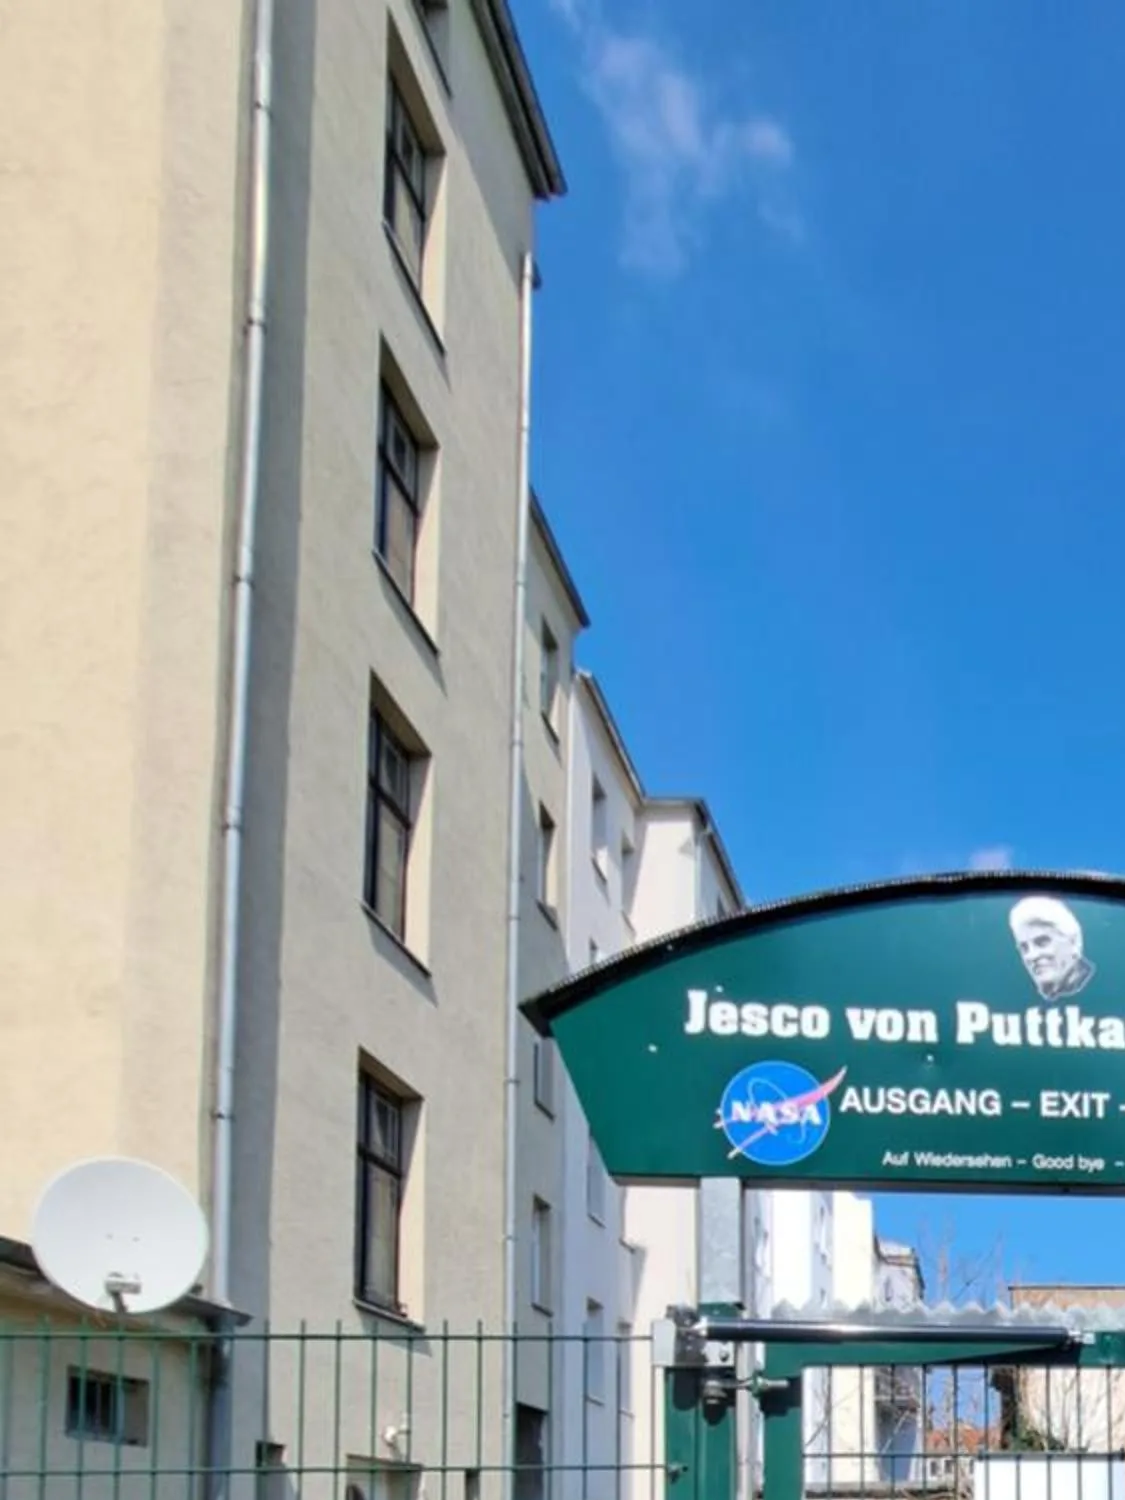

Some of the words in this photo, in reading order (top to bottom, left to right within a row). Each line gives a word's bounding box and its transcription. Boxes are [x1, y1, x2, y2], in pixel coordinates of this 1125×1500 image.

[684, 989, 830, 1036] Jesco
[845, 1007, 938, 1043] von
[731, 1101, 822, 1125] NASA
[839, 1088, 1002, 1115] AUSGANG
[1040, 1091, 1110, 1118] EXIT
[882, 1151, 908, 1166] Auf
[914, 1152, 1012, 1168] Wiedersehen
[1032, 1153, 1073, 1170] Good
[1077, 1155, 1104, 1174] bye
